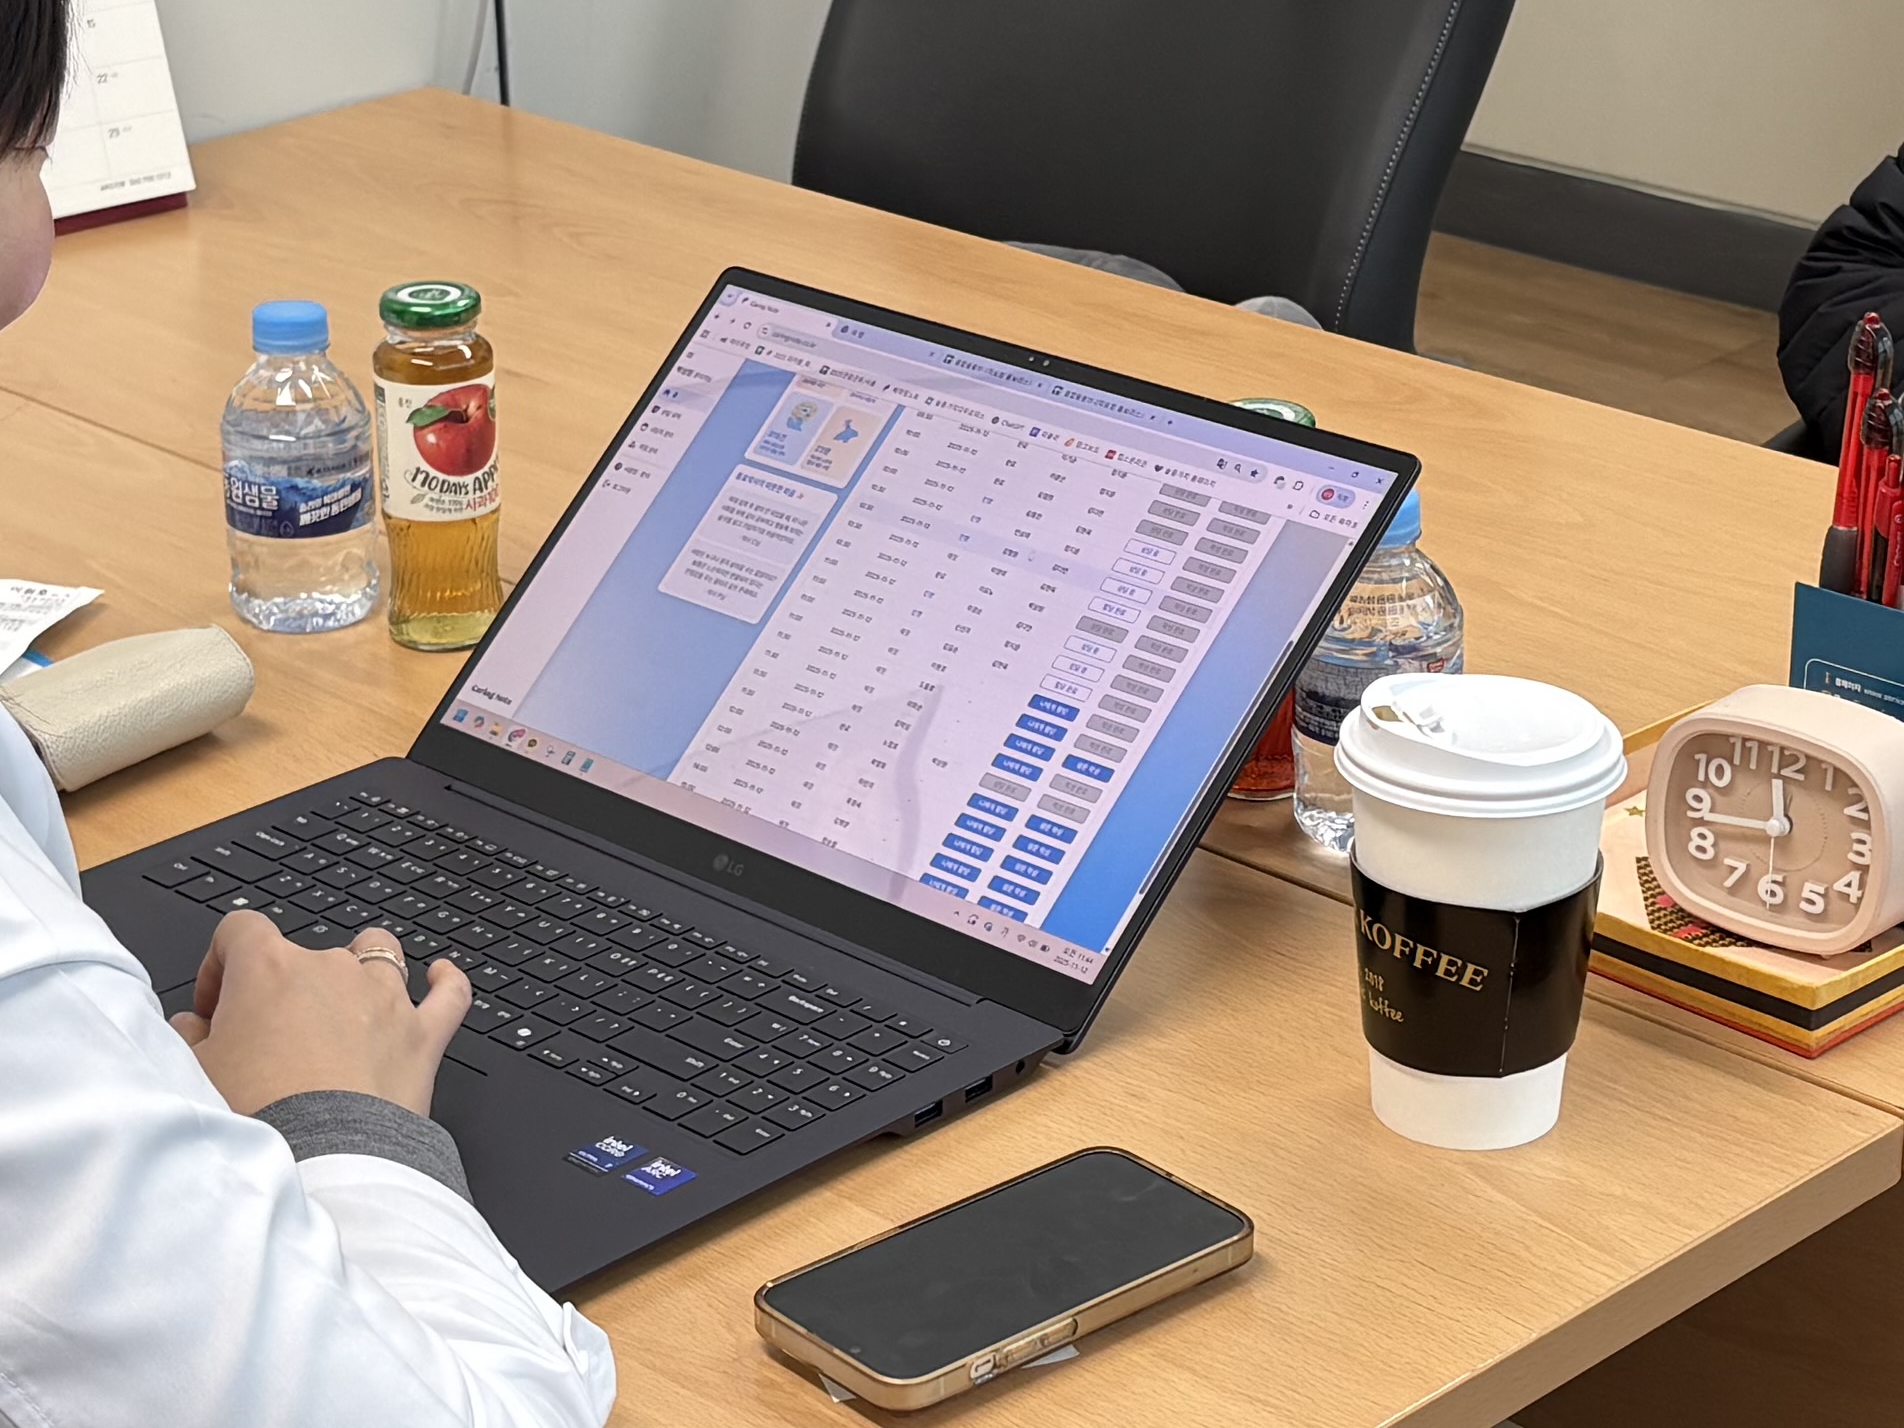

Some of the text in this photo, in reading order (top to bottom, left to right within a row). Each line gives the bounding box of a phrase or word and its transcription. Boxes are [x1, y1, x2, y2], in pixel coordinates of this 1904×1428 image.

[473, 460, 498, 495] APP
[1835, 678, 1862, 692] 홈페이지
[1729, 736, 1758, 769] 11
[1767, 745, 1805, 781] 12
[1694, 753, 1732, 788] 10
[1821, 762, 1836, 791] 1
[1685, 788, 1712, 820] 9
[1843, 786, 1869, 820] 2
[1687, 827, 1716, 861] 8
[1847, 832, 1873, 866] 3
[727, 861, 745, 877] LG
[1723, 858, 1751, 888] 7
[1757, 874, 1785, 906] 6
[1799, 879, 1829, 915] 5
[1832, 870, 1864, 904] 4
[1360, 909, 1489, 992] KOFFEE
